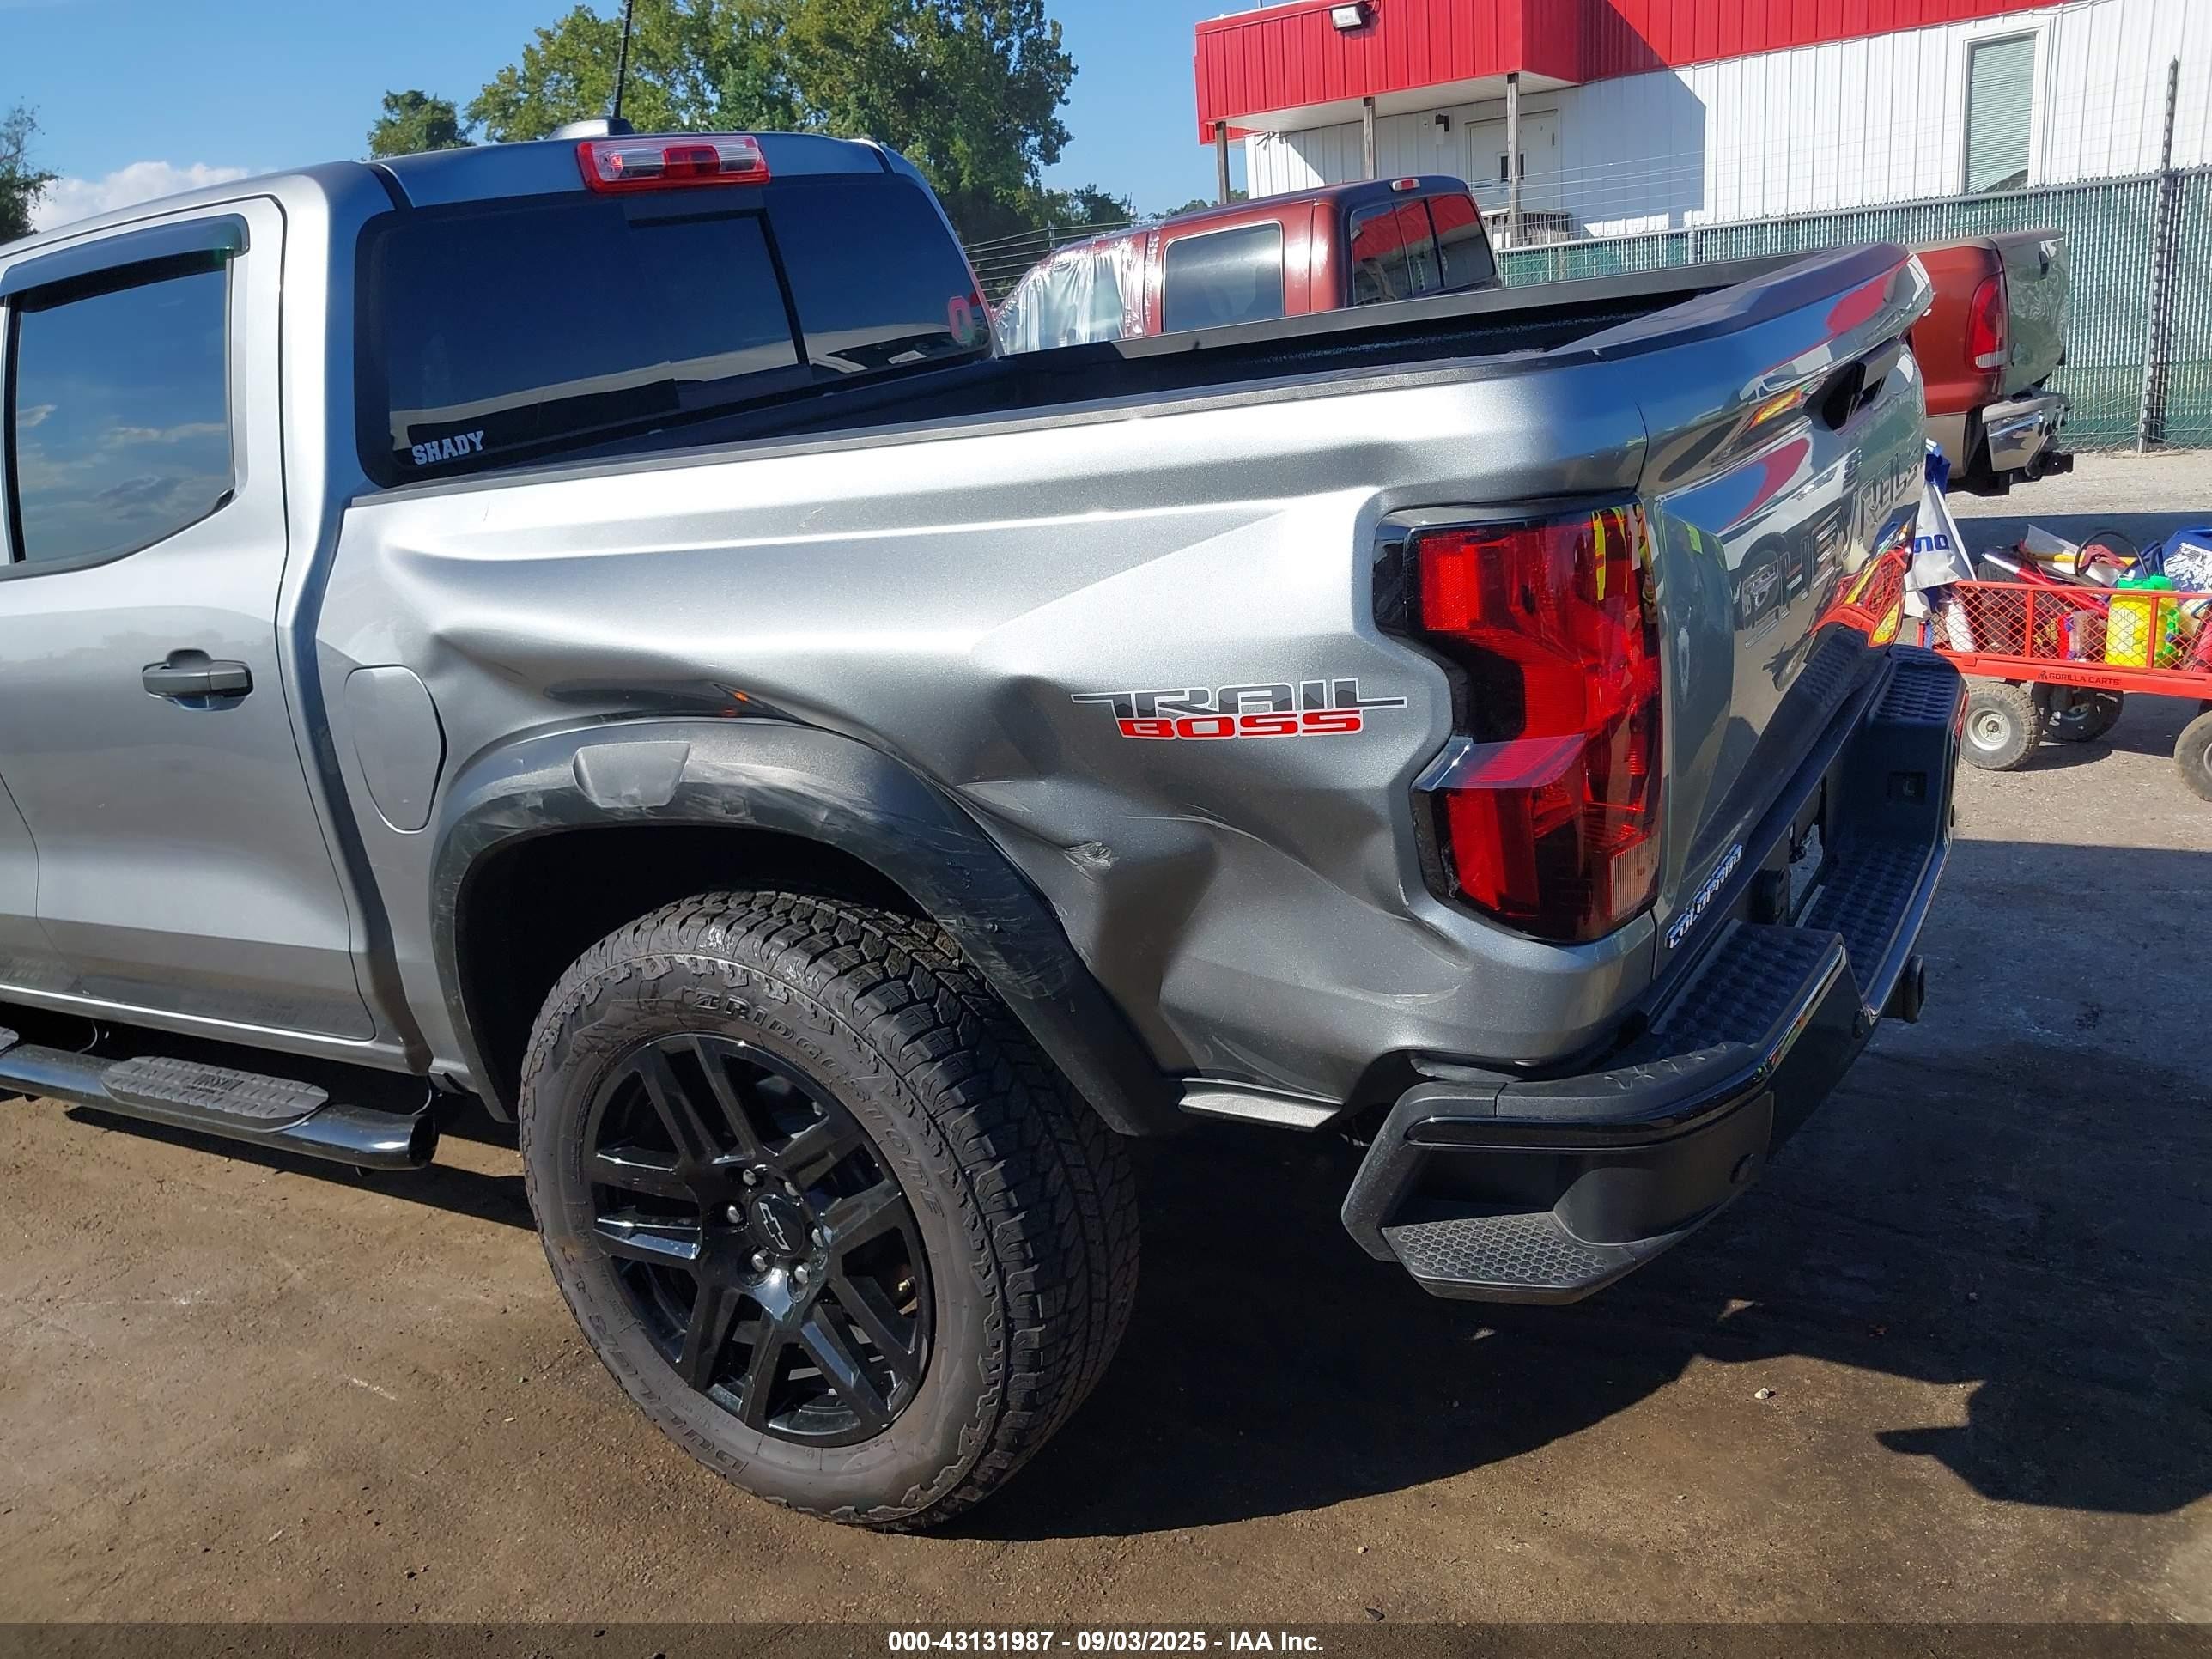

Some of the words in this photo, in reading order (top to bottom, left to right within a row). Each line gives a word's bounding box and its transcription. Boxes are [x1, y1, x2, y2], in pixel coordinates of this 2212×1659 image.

[412, 430, 484, 465] SHADY
[2049, 672, 2086, 683] GORILLA
[2088, 676, 2120, 685] CARTS
[1070, 678, 1407, 717] TRAIL
[1117, 708, 1364, 740] BOSS
[1664, 843, 1743, 949] COLORADO
